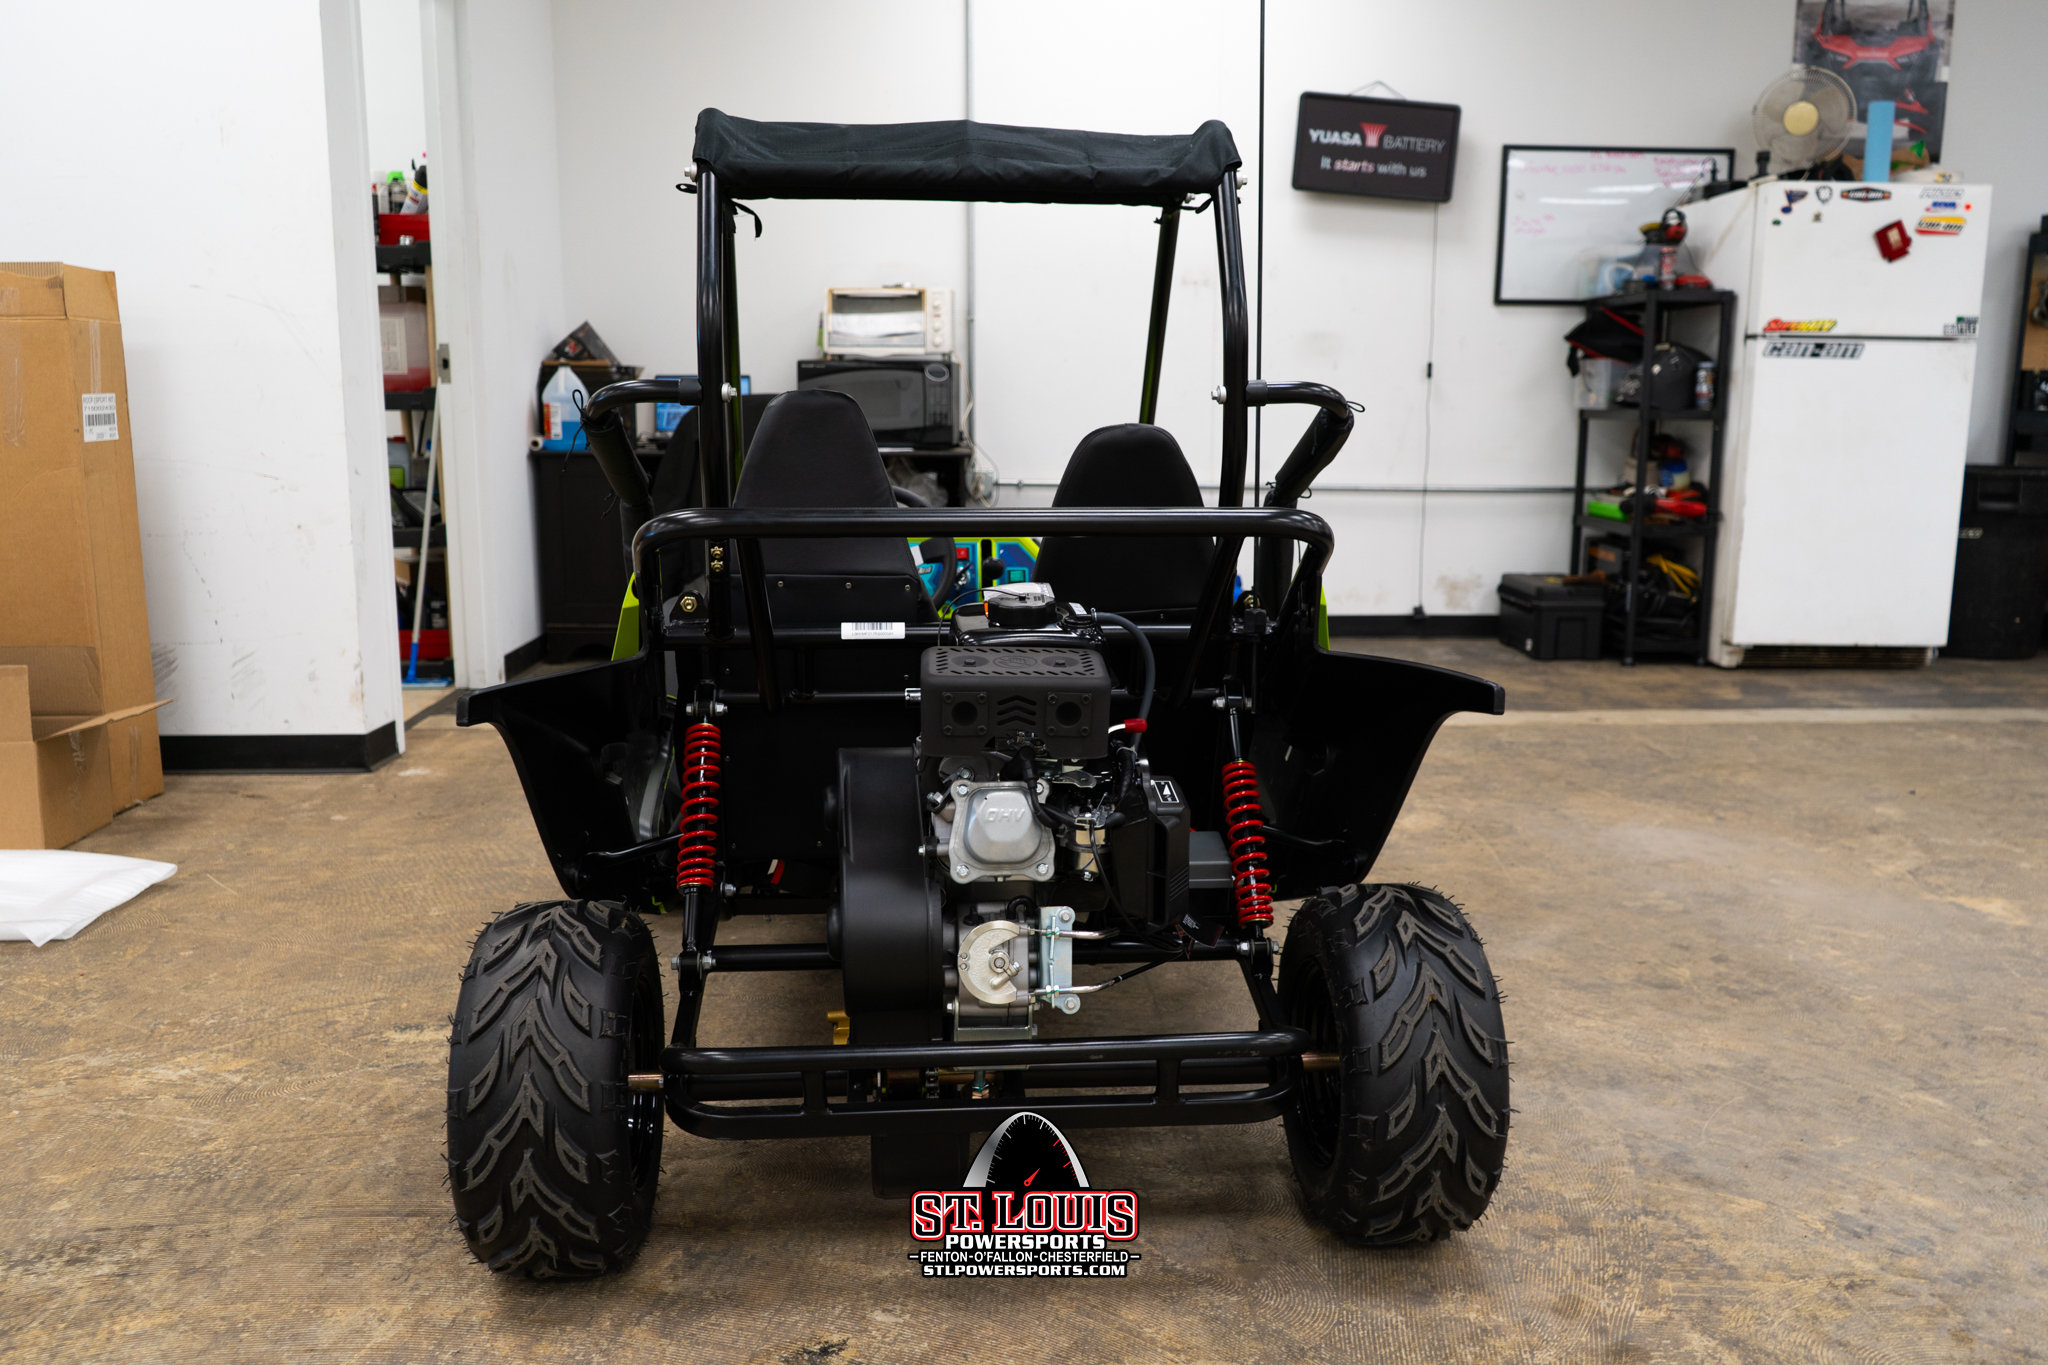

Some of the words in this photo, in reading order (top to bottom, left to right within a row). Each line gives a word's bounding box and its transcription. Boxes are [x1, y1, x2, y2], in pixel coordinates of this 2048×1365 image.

[1309, 128, 1362, 146] YUASA
[1383, 135, 1446, 154] BATTERY
[1334, 158, 1375, 173] starts
[1377, 162, 1407, 175] with
[1410, 166, 1427, 178] us
[986, 808, 1025, 822] OHV
